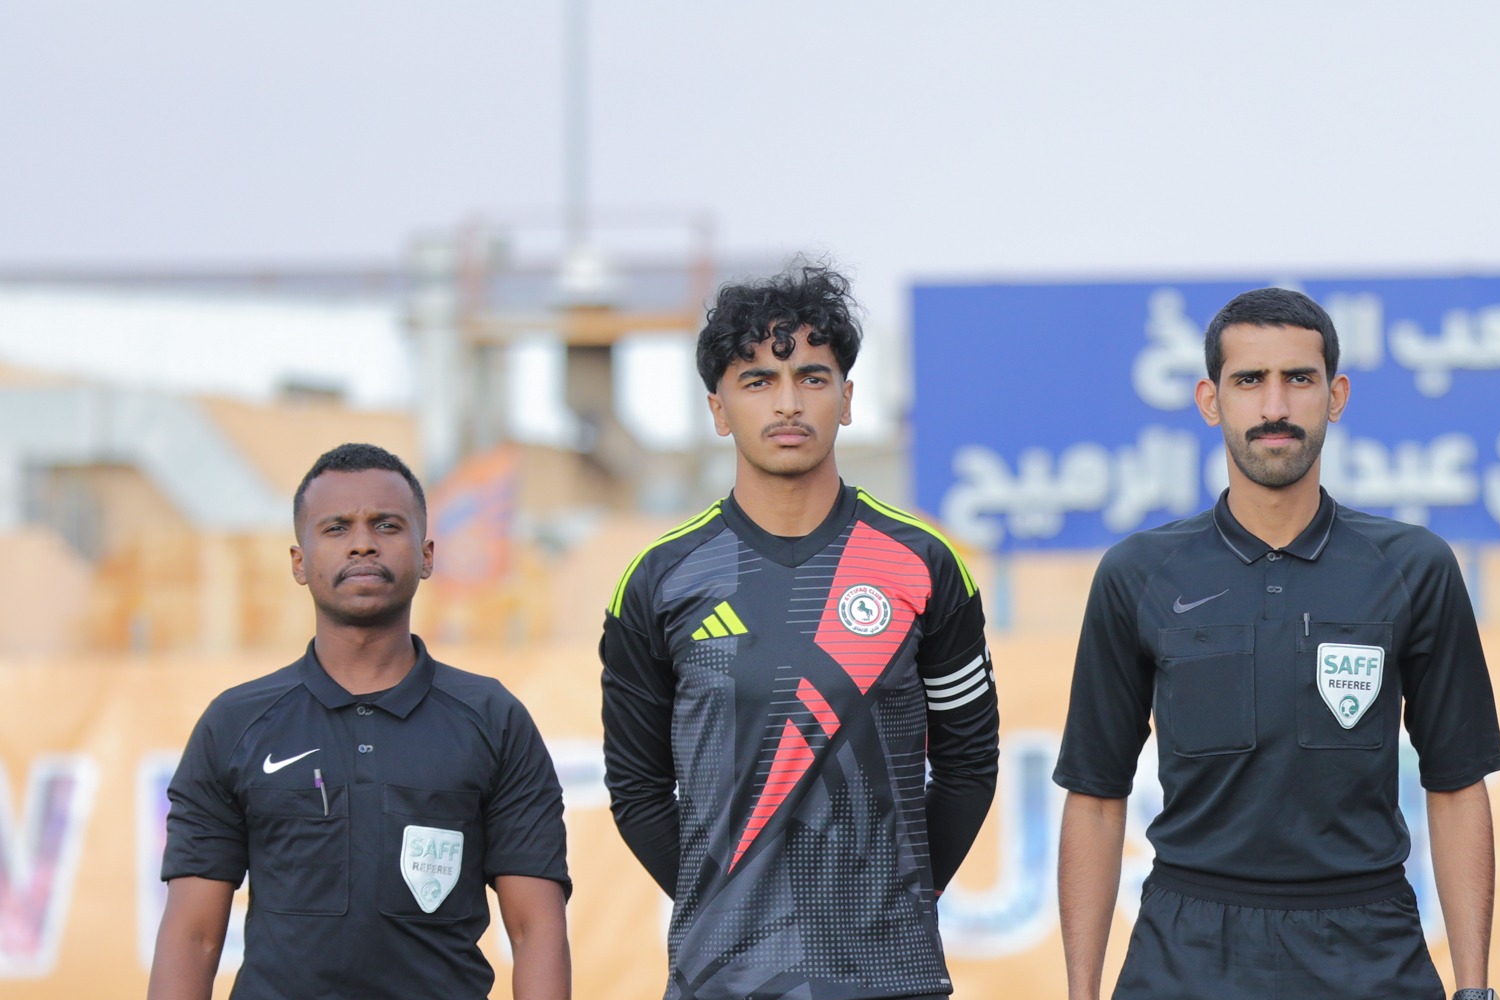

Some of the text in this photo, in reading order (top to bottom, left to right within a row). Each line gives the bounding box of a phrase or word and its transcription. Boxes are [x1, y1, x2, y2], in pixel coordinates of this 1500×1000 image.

[1323, 654, 1379, 676] SAFF
[1328, 679, 1372, 691] REFEREE
[409, 837, 460, 861] SAFF
[412, 861, 453, 875] REFEREE
